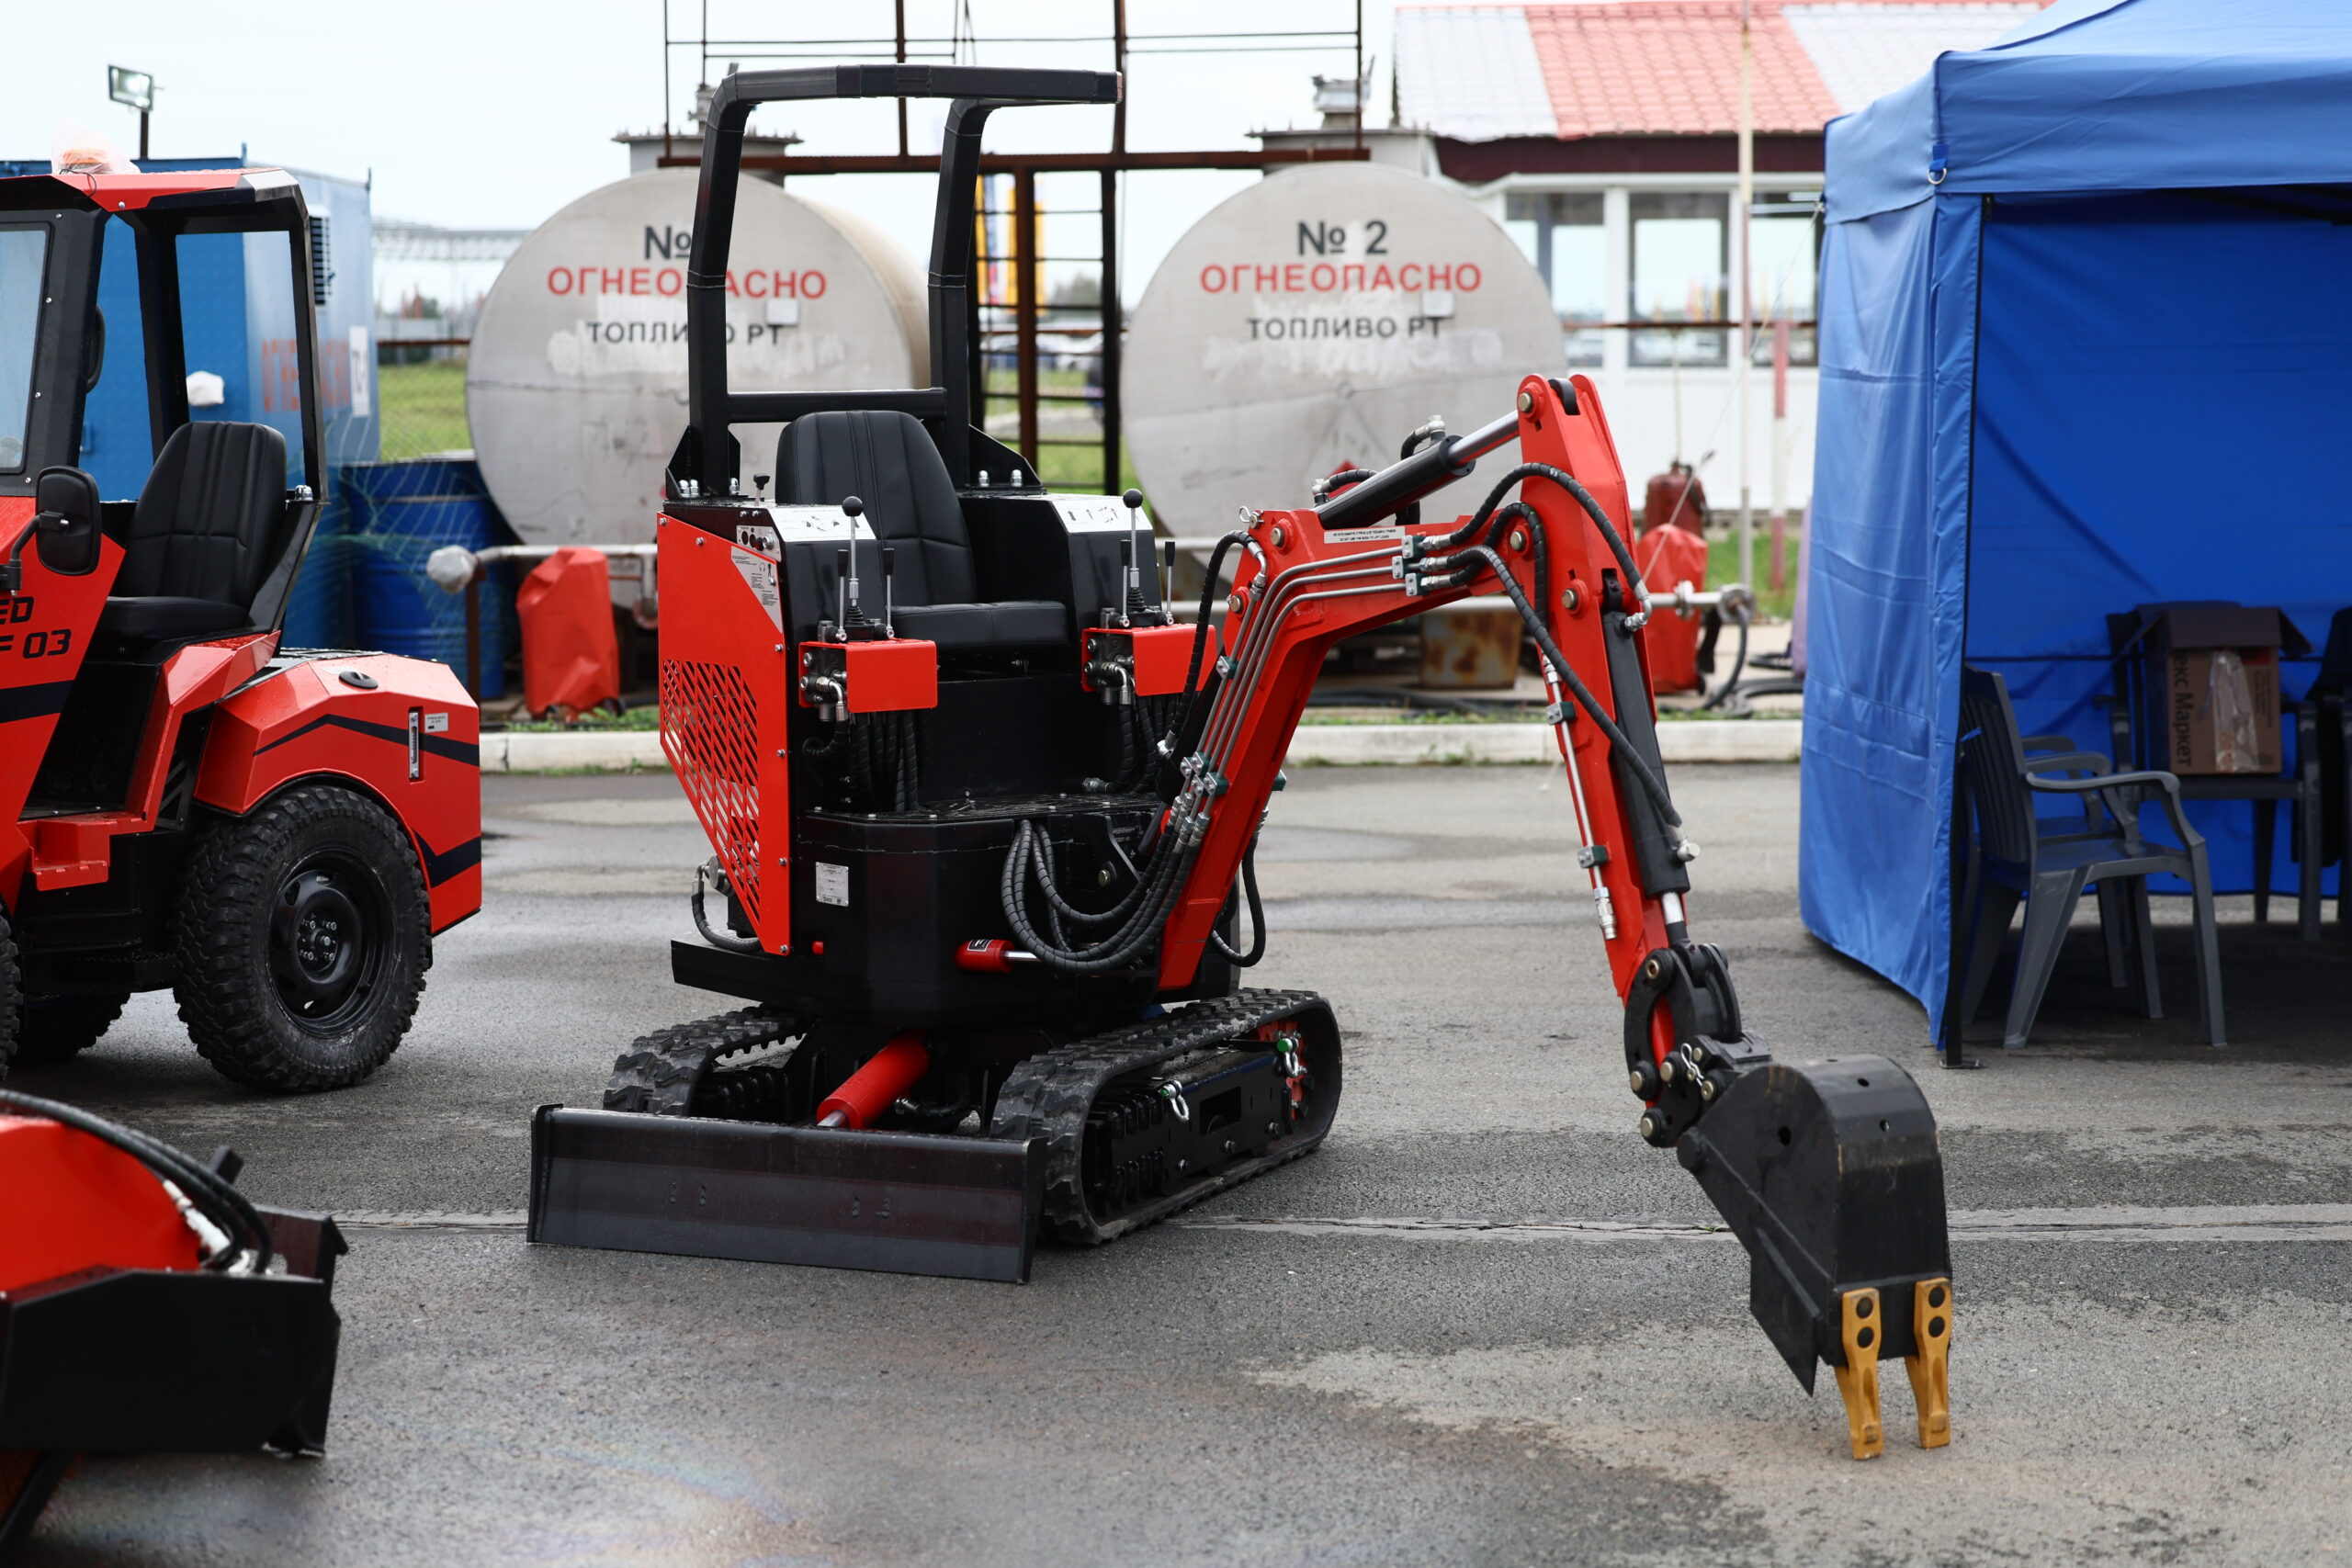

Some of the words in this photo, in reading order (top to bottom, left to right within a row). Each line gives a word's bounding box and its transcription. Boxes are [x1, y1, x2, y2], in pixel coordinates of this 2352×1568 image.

[1297, 220, 1346, 255] №
[1365, 220, 1388, 254] 2
[547, 266, 826, 299] ОГНЕОАСНО
[1200, 263, 1482, 294] ОГНЕОПАСНО
[747, 323, 784, 344] РТ
[1247, 317, 1396, 340] ТОПЛИВО
[1408, 317, 1442, 339] РТ
[23, 628, 72, 659] 03
[2173, 693, 2194, 766] Маркет
